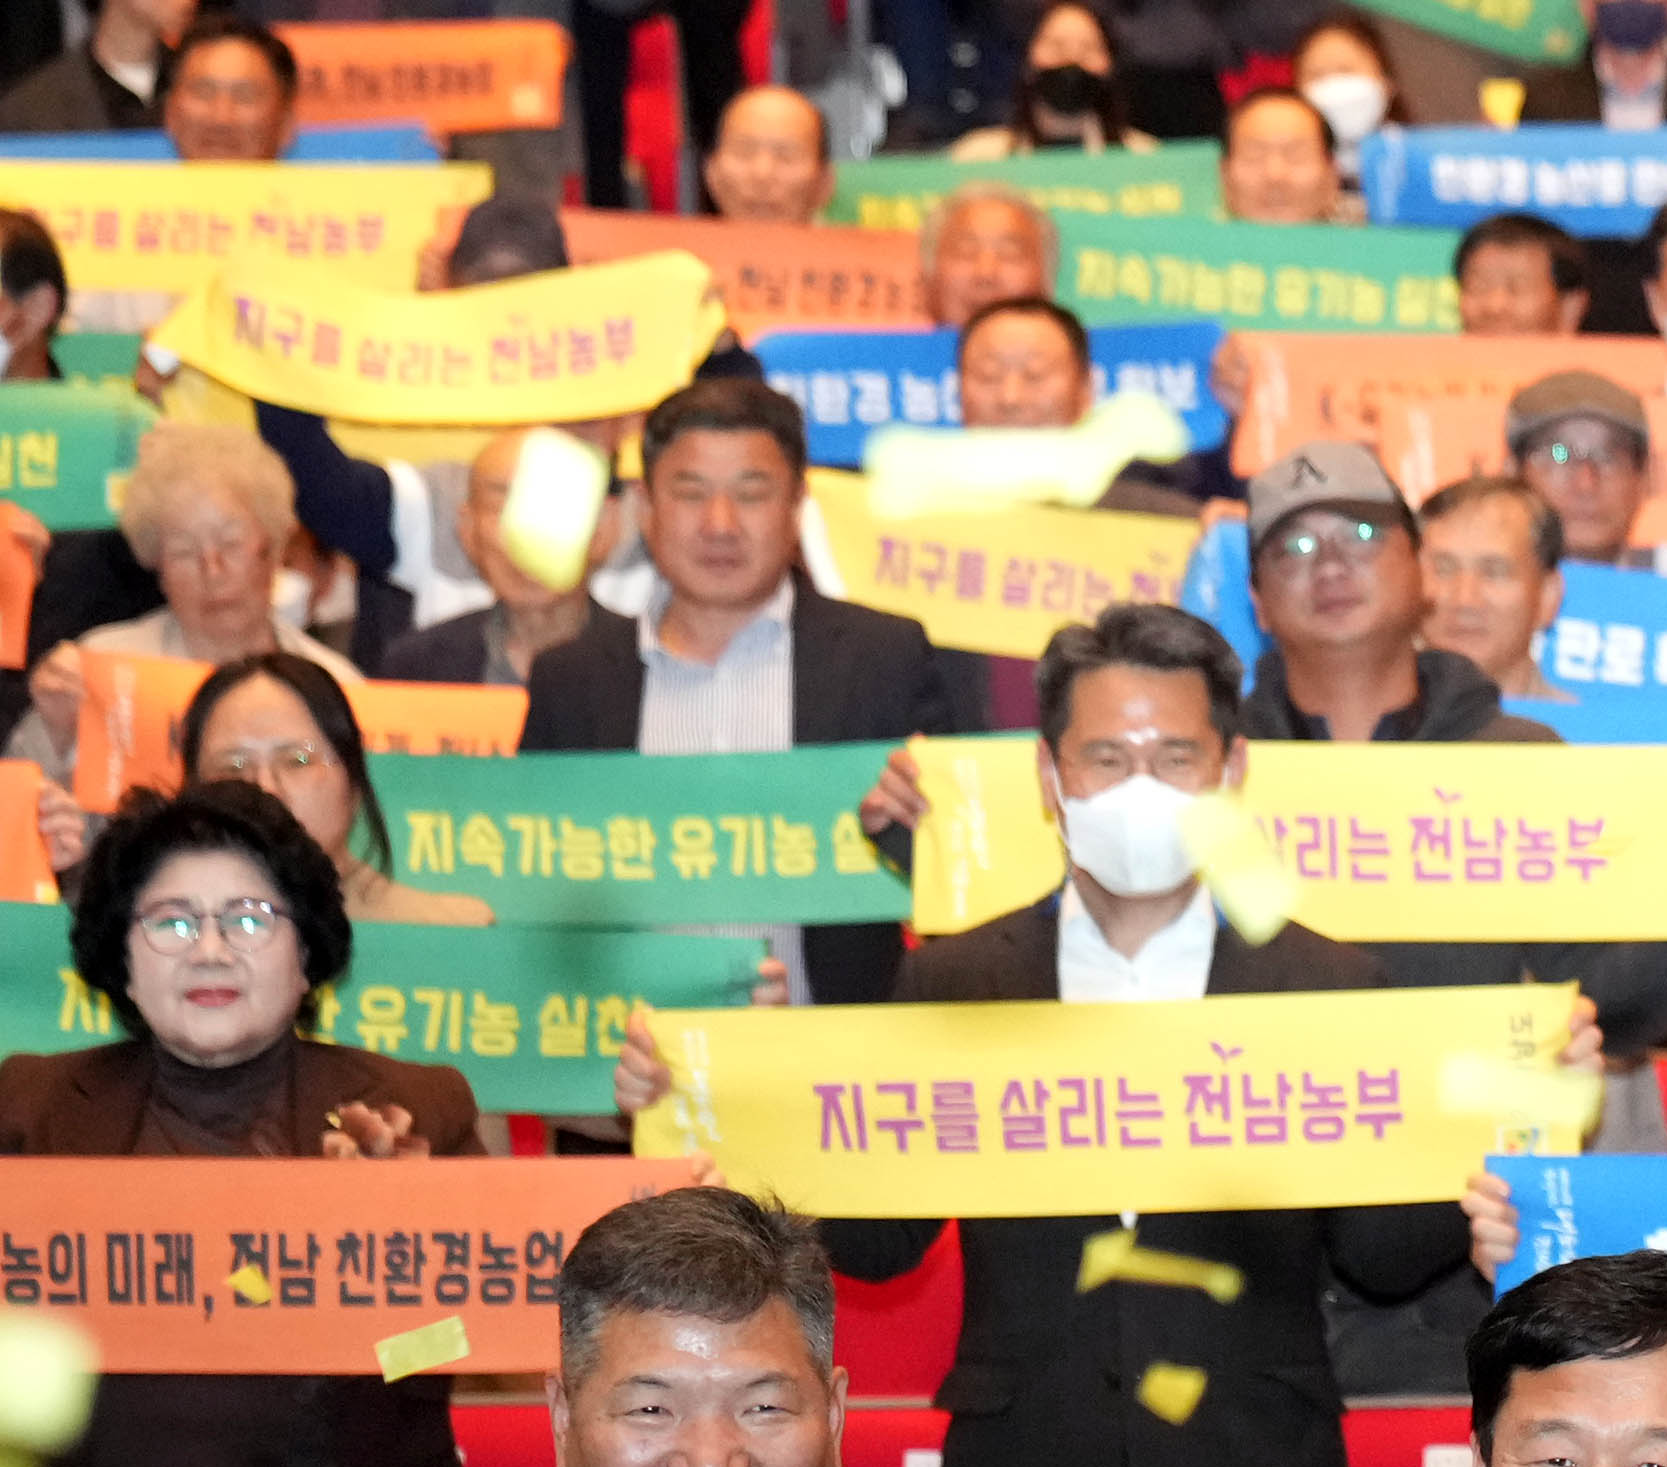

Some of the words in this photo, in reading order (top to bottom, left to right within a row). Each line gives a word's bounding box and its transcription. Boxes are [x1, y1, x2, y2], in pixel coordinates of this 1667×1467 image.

[876, 534, 987, 604] 지구를
[1553, 617, 1646, 687] 판로
[406, 811, 657, 881] 지속가능한
[670, 815, 817, 879] 유기농
[1409, 815, 1608, 884] 전남농부
[356, 983, 521, 1058] 유기농
[813, 1079, 982, 1154] 지구를
[1000, 1077, 1163, 1151] 살리는
[1182, 1067, 1404, 1149] 전남농부
[106, 1230, 214, 1321] 미래,
[335, 1229, 563, 1309] 친환경농업
